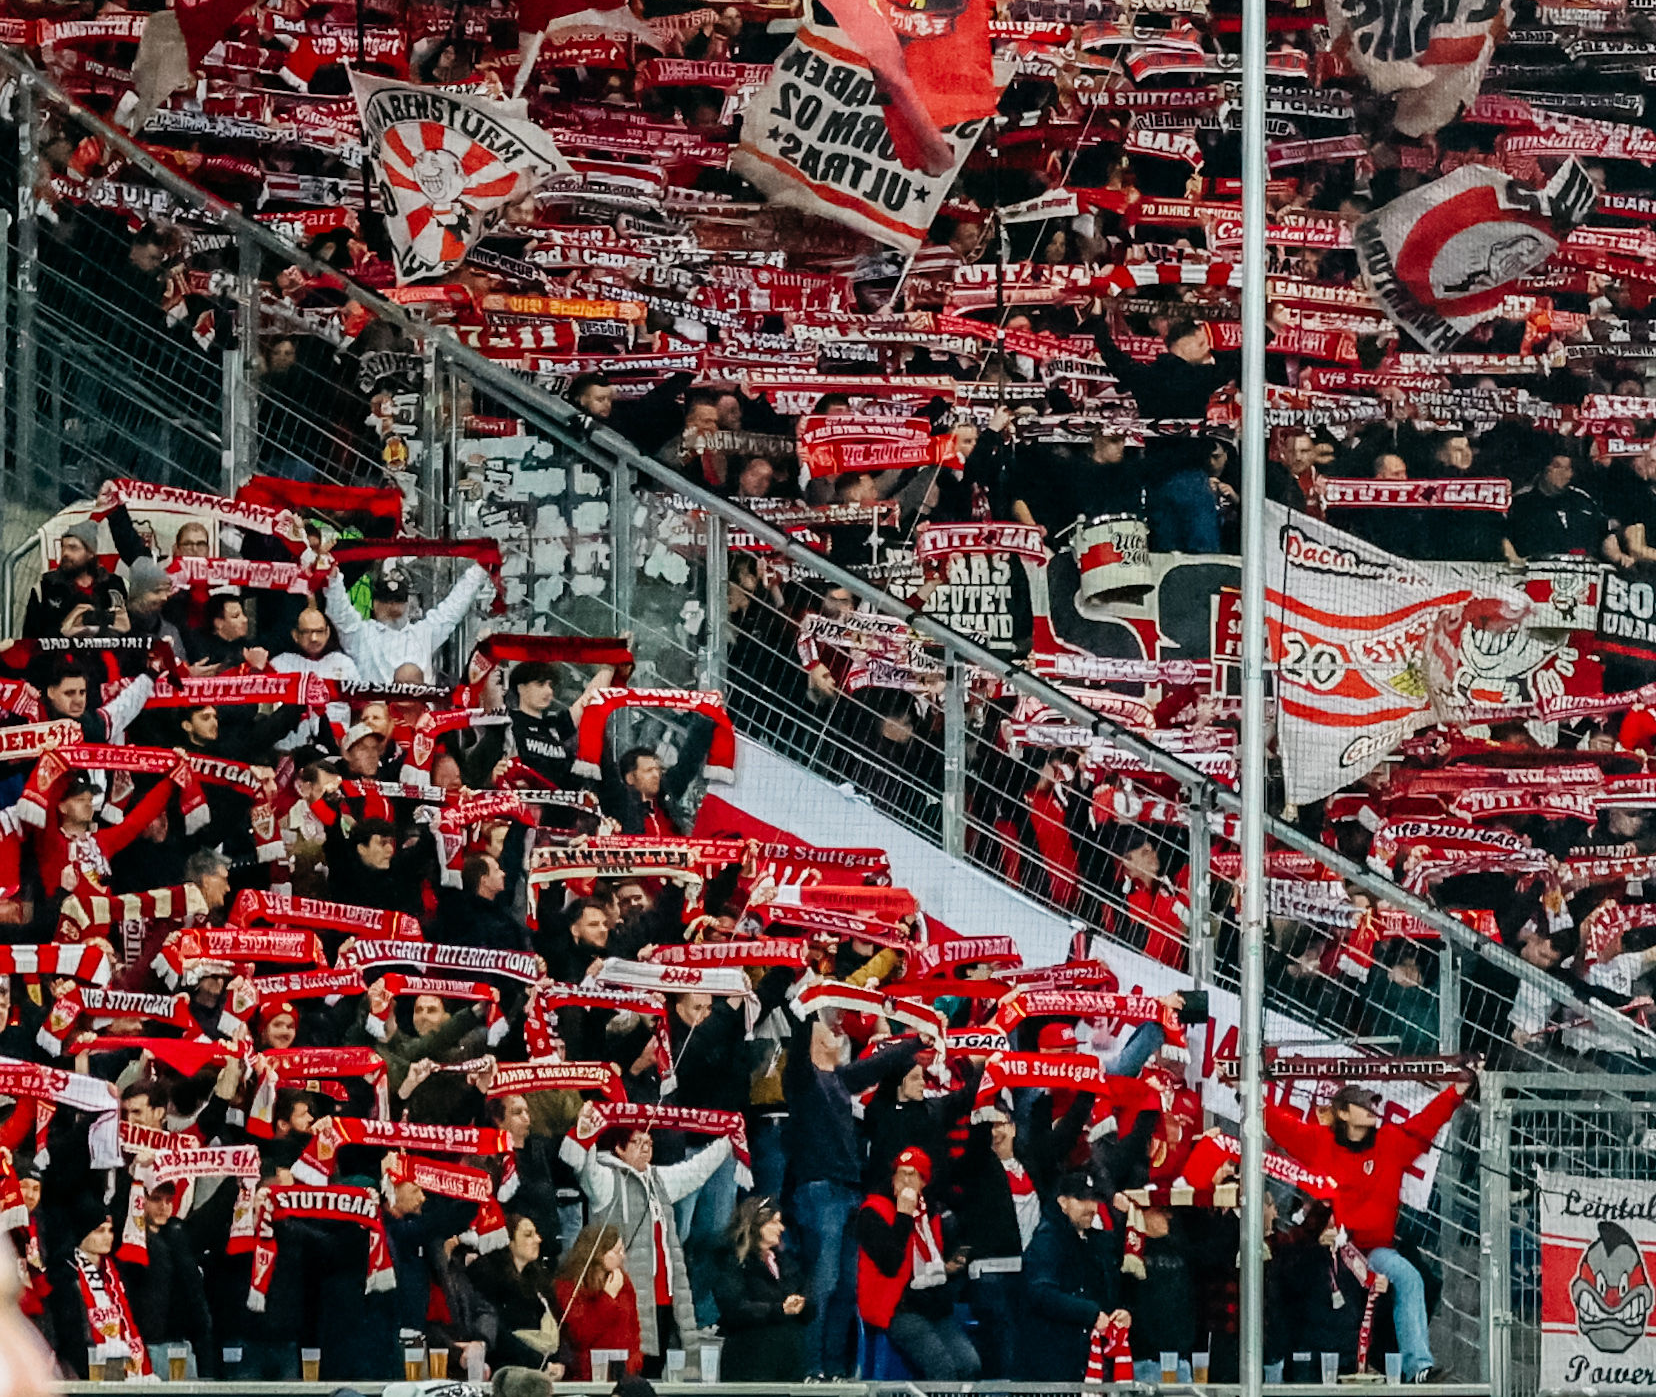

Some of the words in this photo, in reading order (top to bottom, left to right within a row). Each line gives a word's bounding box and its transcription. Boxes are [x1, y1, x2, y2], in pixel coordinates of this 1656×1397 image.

[1320, 372, 1355, 387] VfB
[1361, 374, 1441, 389] STUTTGART
[120, 482, 154, 500] VfB
[161, 488, 275, 527] STUTTGART
[1283, 631, 1336, 689] 20
[180, 678, 287, 696] STUTTGART
[264, 892, 294, 913] VfB
[301, 898, 384, 929] STUTTGART
[81, 988, 108, 1007] VfB
[112, 993, 179, 1017] STUTTGART
[603, 1103, 638, 1122] VfB
[644, 1105, 739, 1130] Stuttgart
[361, 1119, 395, 1135] VfB
[401, 1123, 480, 1144] Stuttgart
